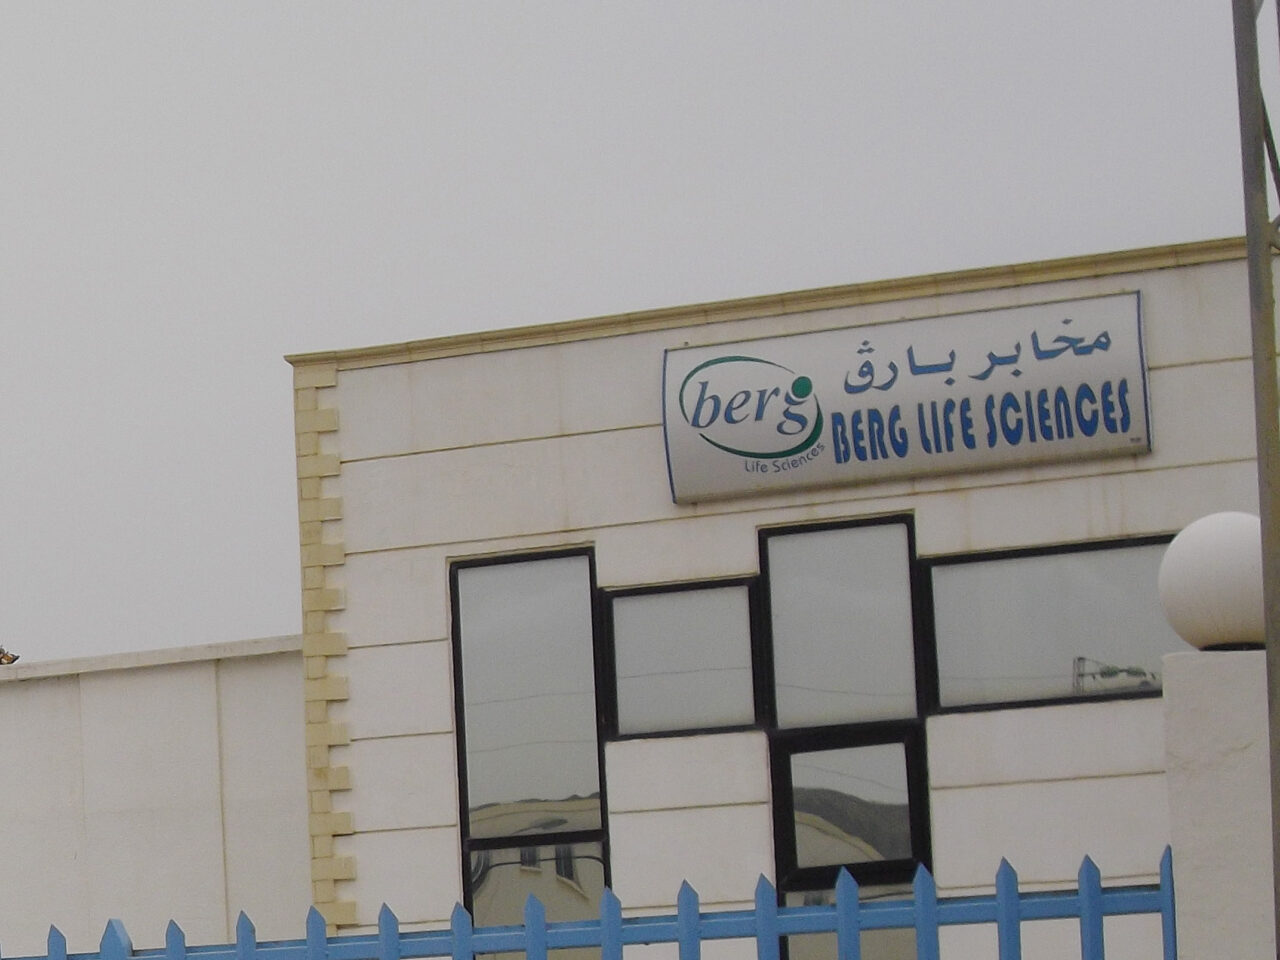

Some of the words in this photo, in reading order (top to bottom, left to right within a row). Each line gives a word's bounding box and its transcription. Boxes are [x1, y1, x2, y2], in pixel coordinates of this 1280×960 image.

[969, 318, 1112, 382] مخابر
[691, 376, 813, 435] berg
[830, 404, 909, 464] BERG
[918, 397, 977, 454] LIFE
[985, 377, 1132, 448] SCIENCES
[744, 460, 769, 474] Life
[772, 442, 826, 474] Sciences
